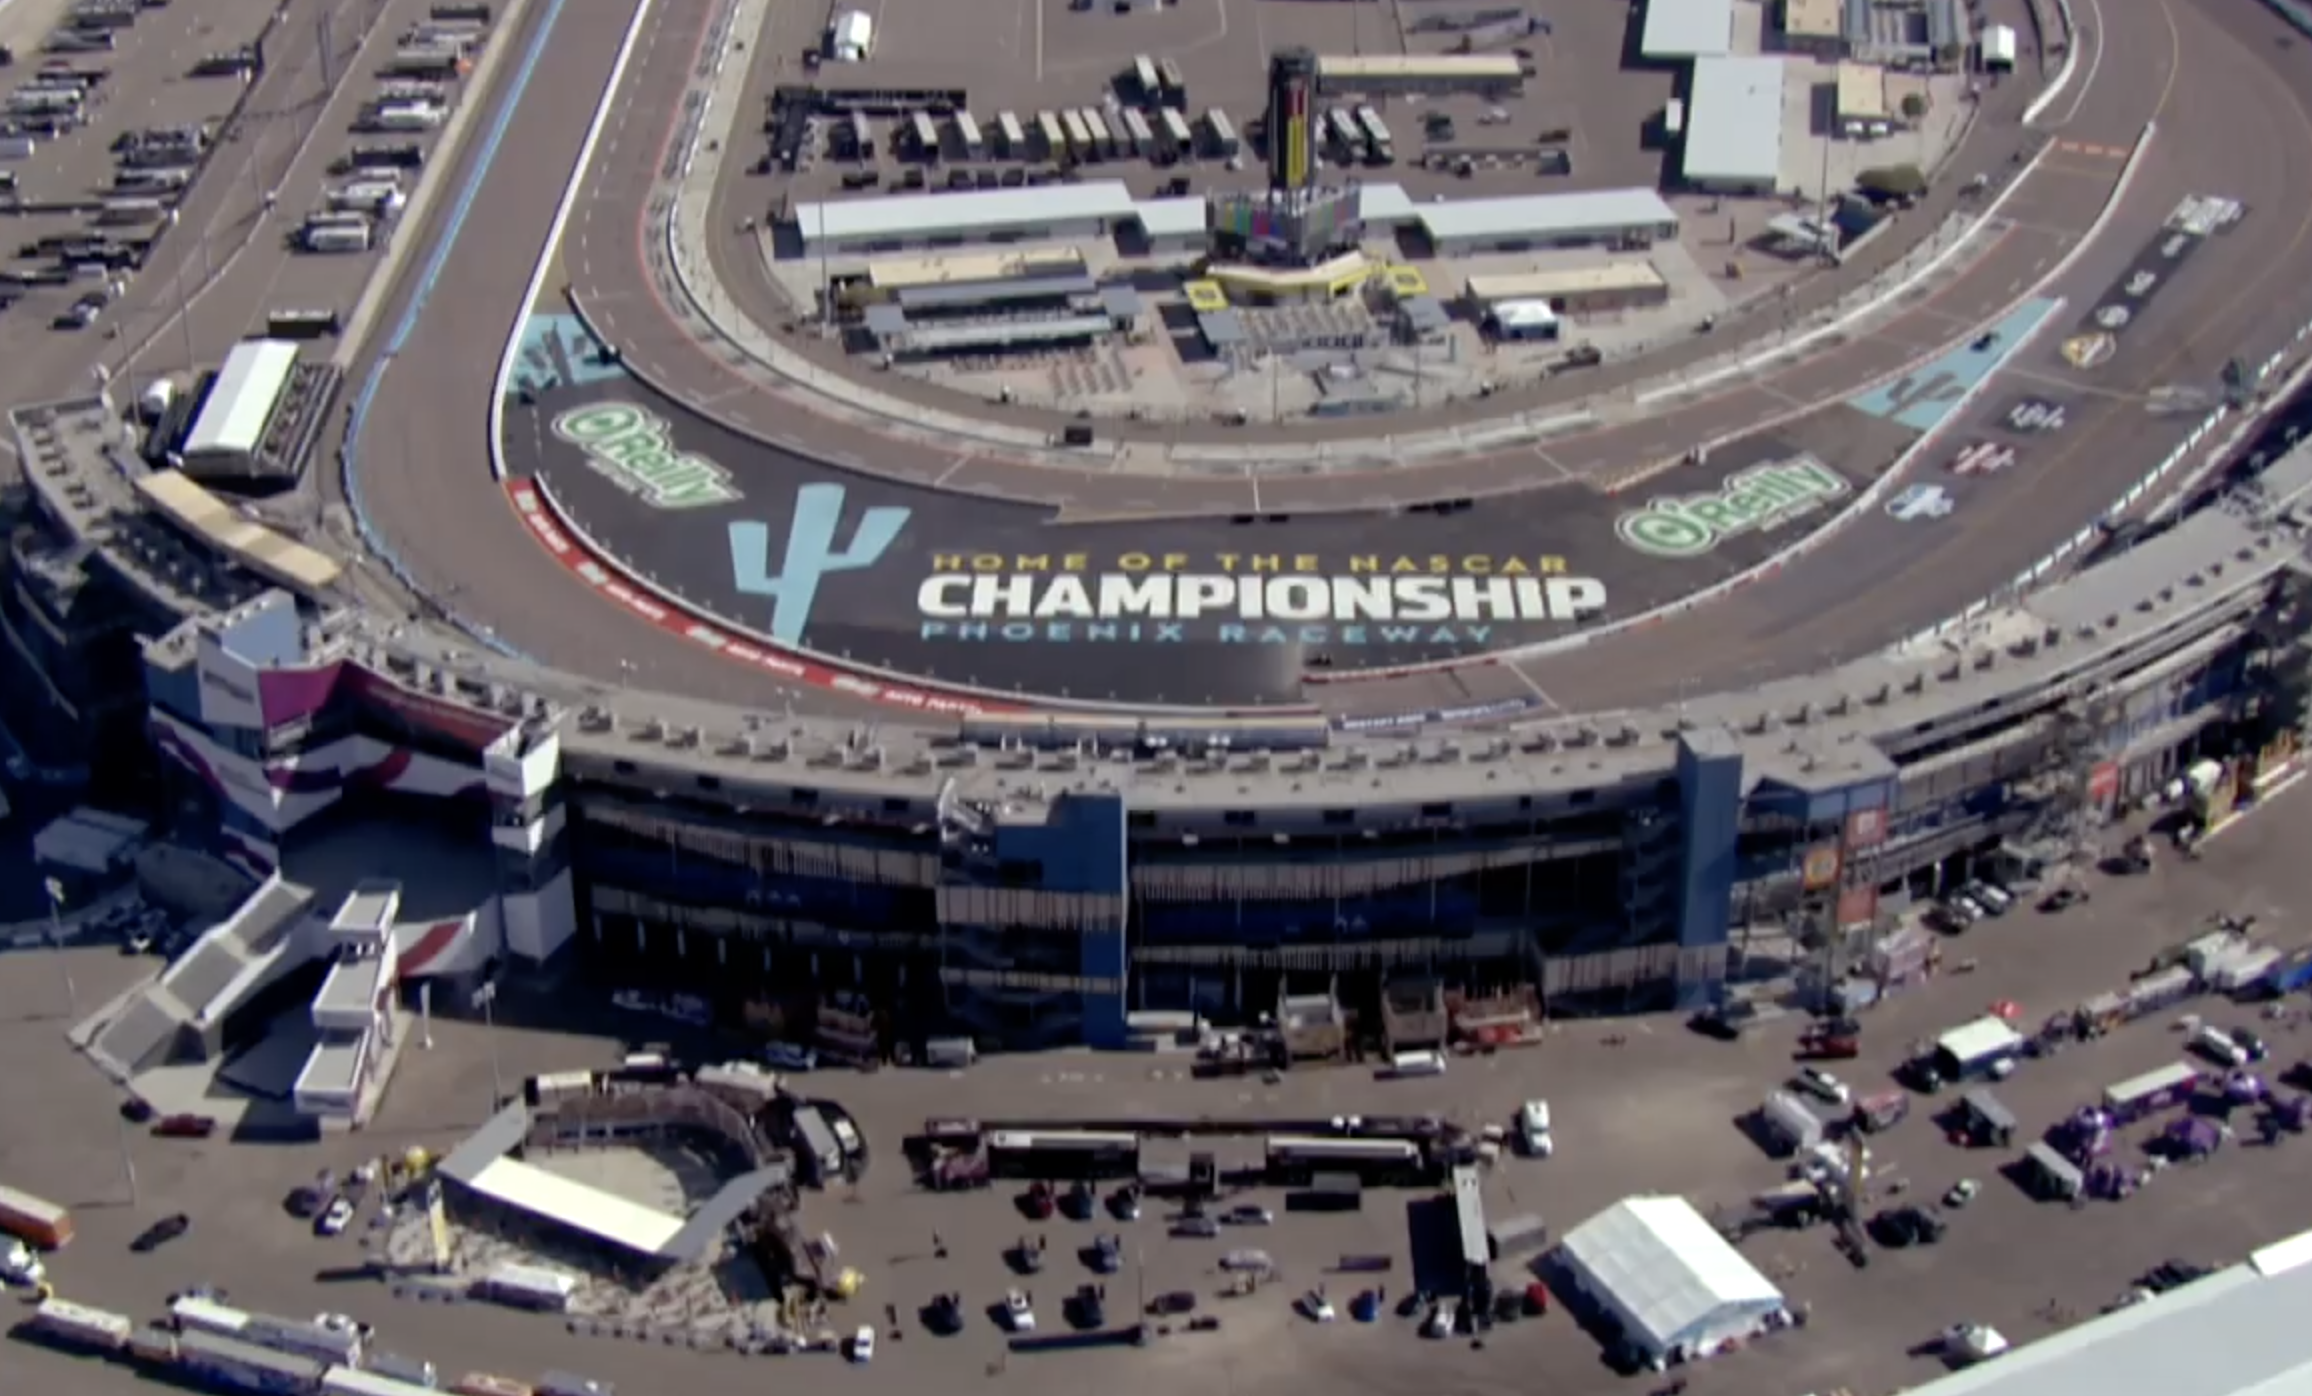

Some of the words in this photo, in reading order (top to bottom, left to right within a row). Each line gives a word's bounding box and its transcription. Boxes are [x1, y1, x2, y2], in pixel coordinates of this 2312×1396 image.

[1615, 454, 1850, 554] O'Reilly
[933, 553, 1088, 571] HOME
[1118, 553, 1187, 571] OF
[1216, 553, 1318, 571] THE
[1350, 554, 1566, 573] NASCAR
[917, 573, 1607, 620] CHAMPIONSHIP
[921, 621, 1183, 642] PHOENIX
[1219, 623, 1491, 644] RACEWAY
